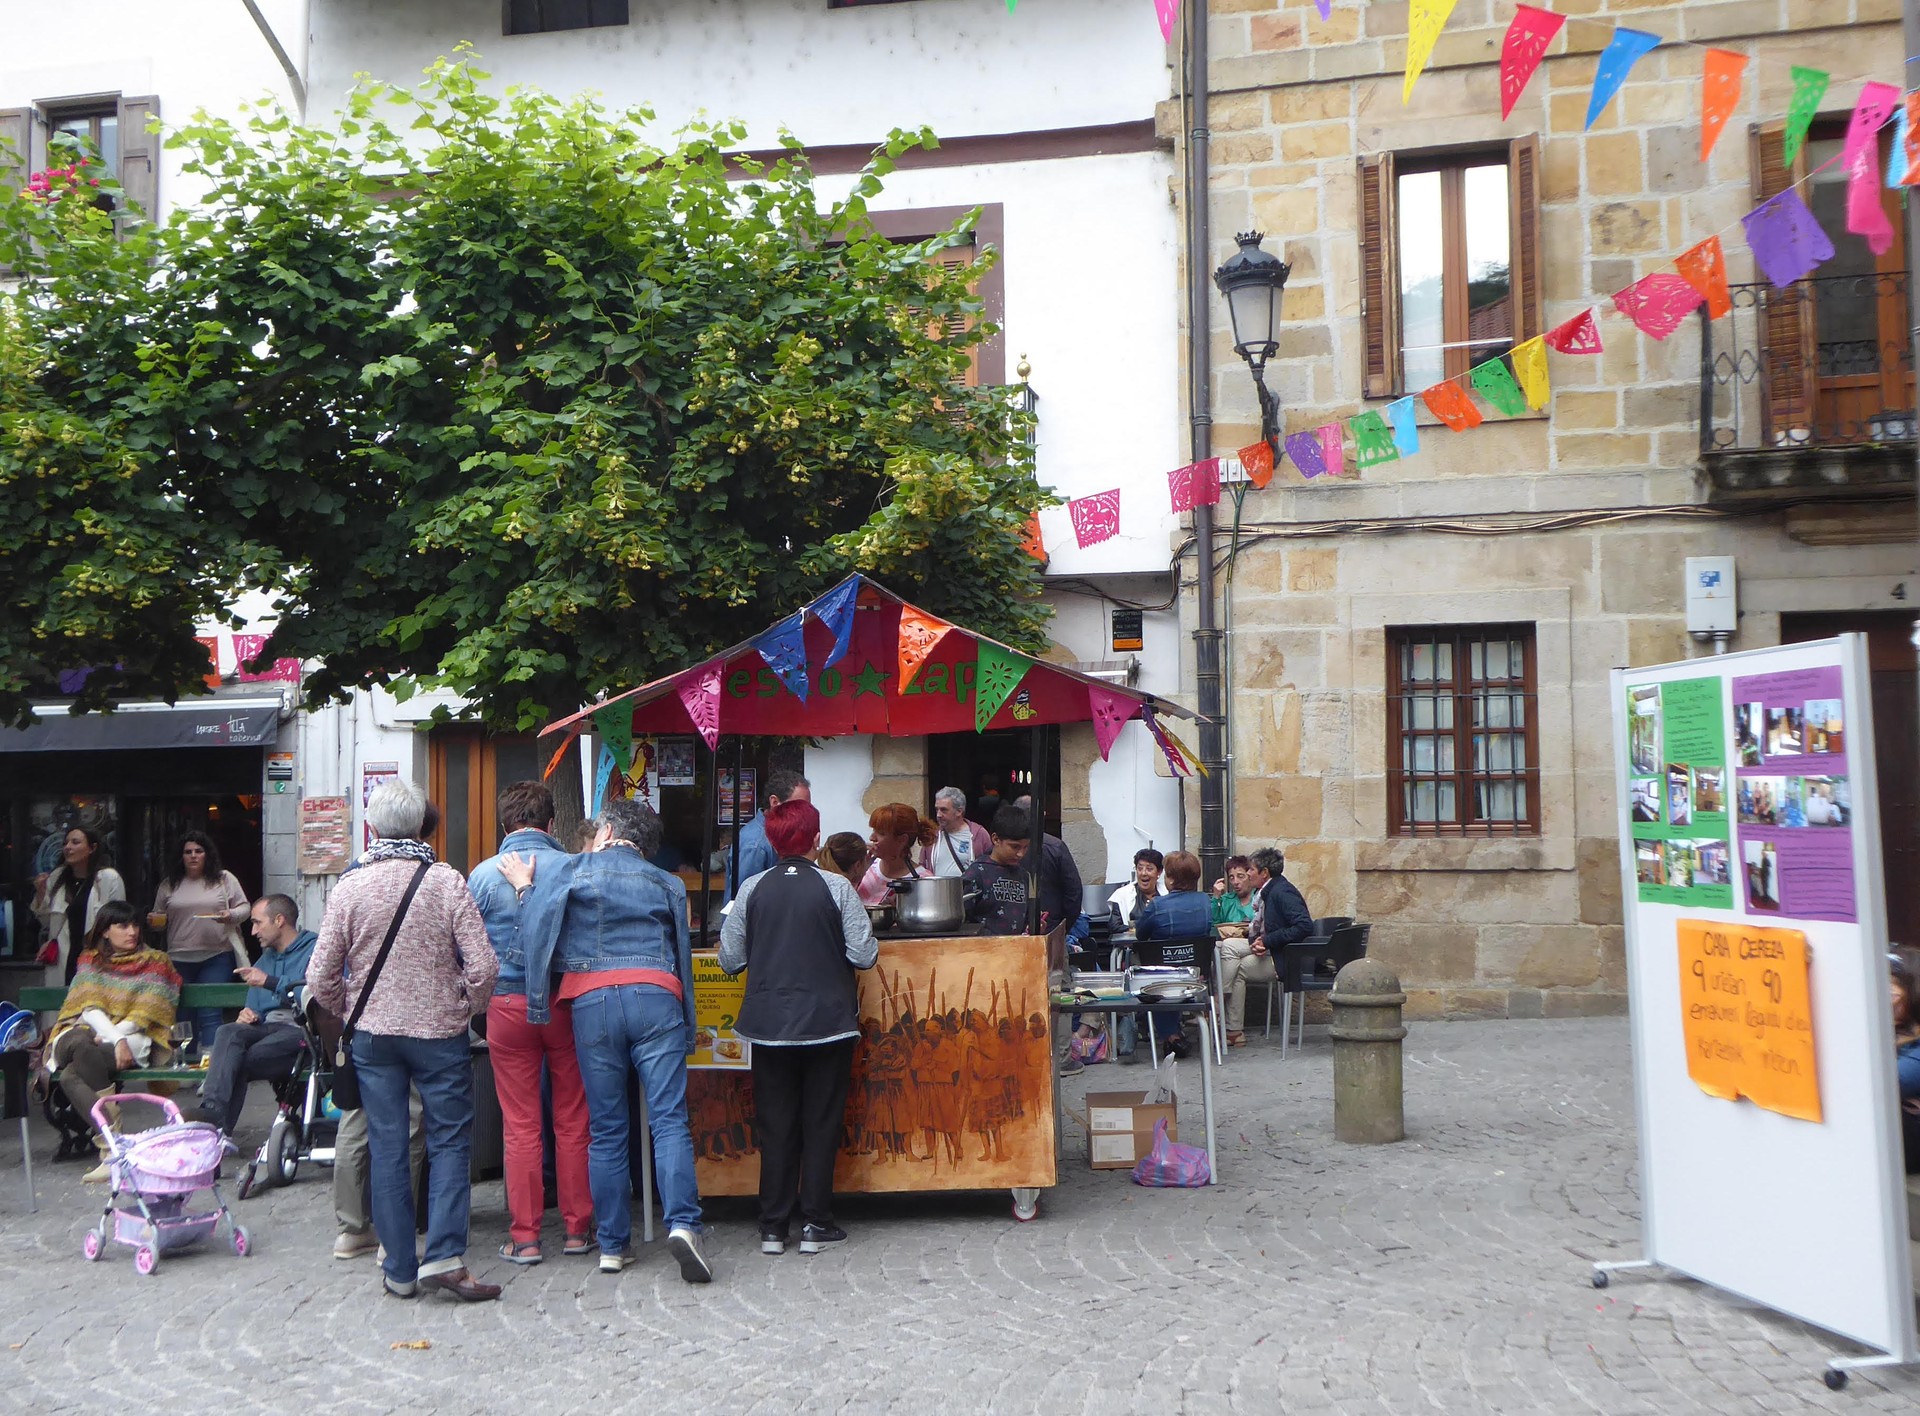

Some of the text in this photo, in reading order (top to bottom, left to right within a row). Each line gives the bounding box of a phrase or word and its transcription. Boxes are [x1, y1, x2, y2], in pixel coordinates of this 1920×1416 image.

[726, 661, 843, 698] eso
[279, 782, 286, 793] 2
[993, 877, 1025, 891] STAR
[994, 889, 1026, 903] WARS
[1173, 947, 1194, 956] SALVE
[1692, 960, 1706, 992] 9
[1762, 969, 1783, 1004] 90
[721, 1014, 734, 1030] 2
